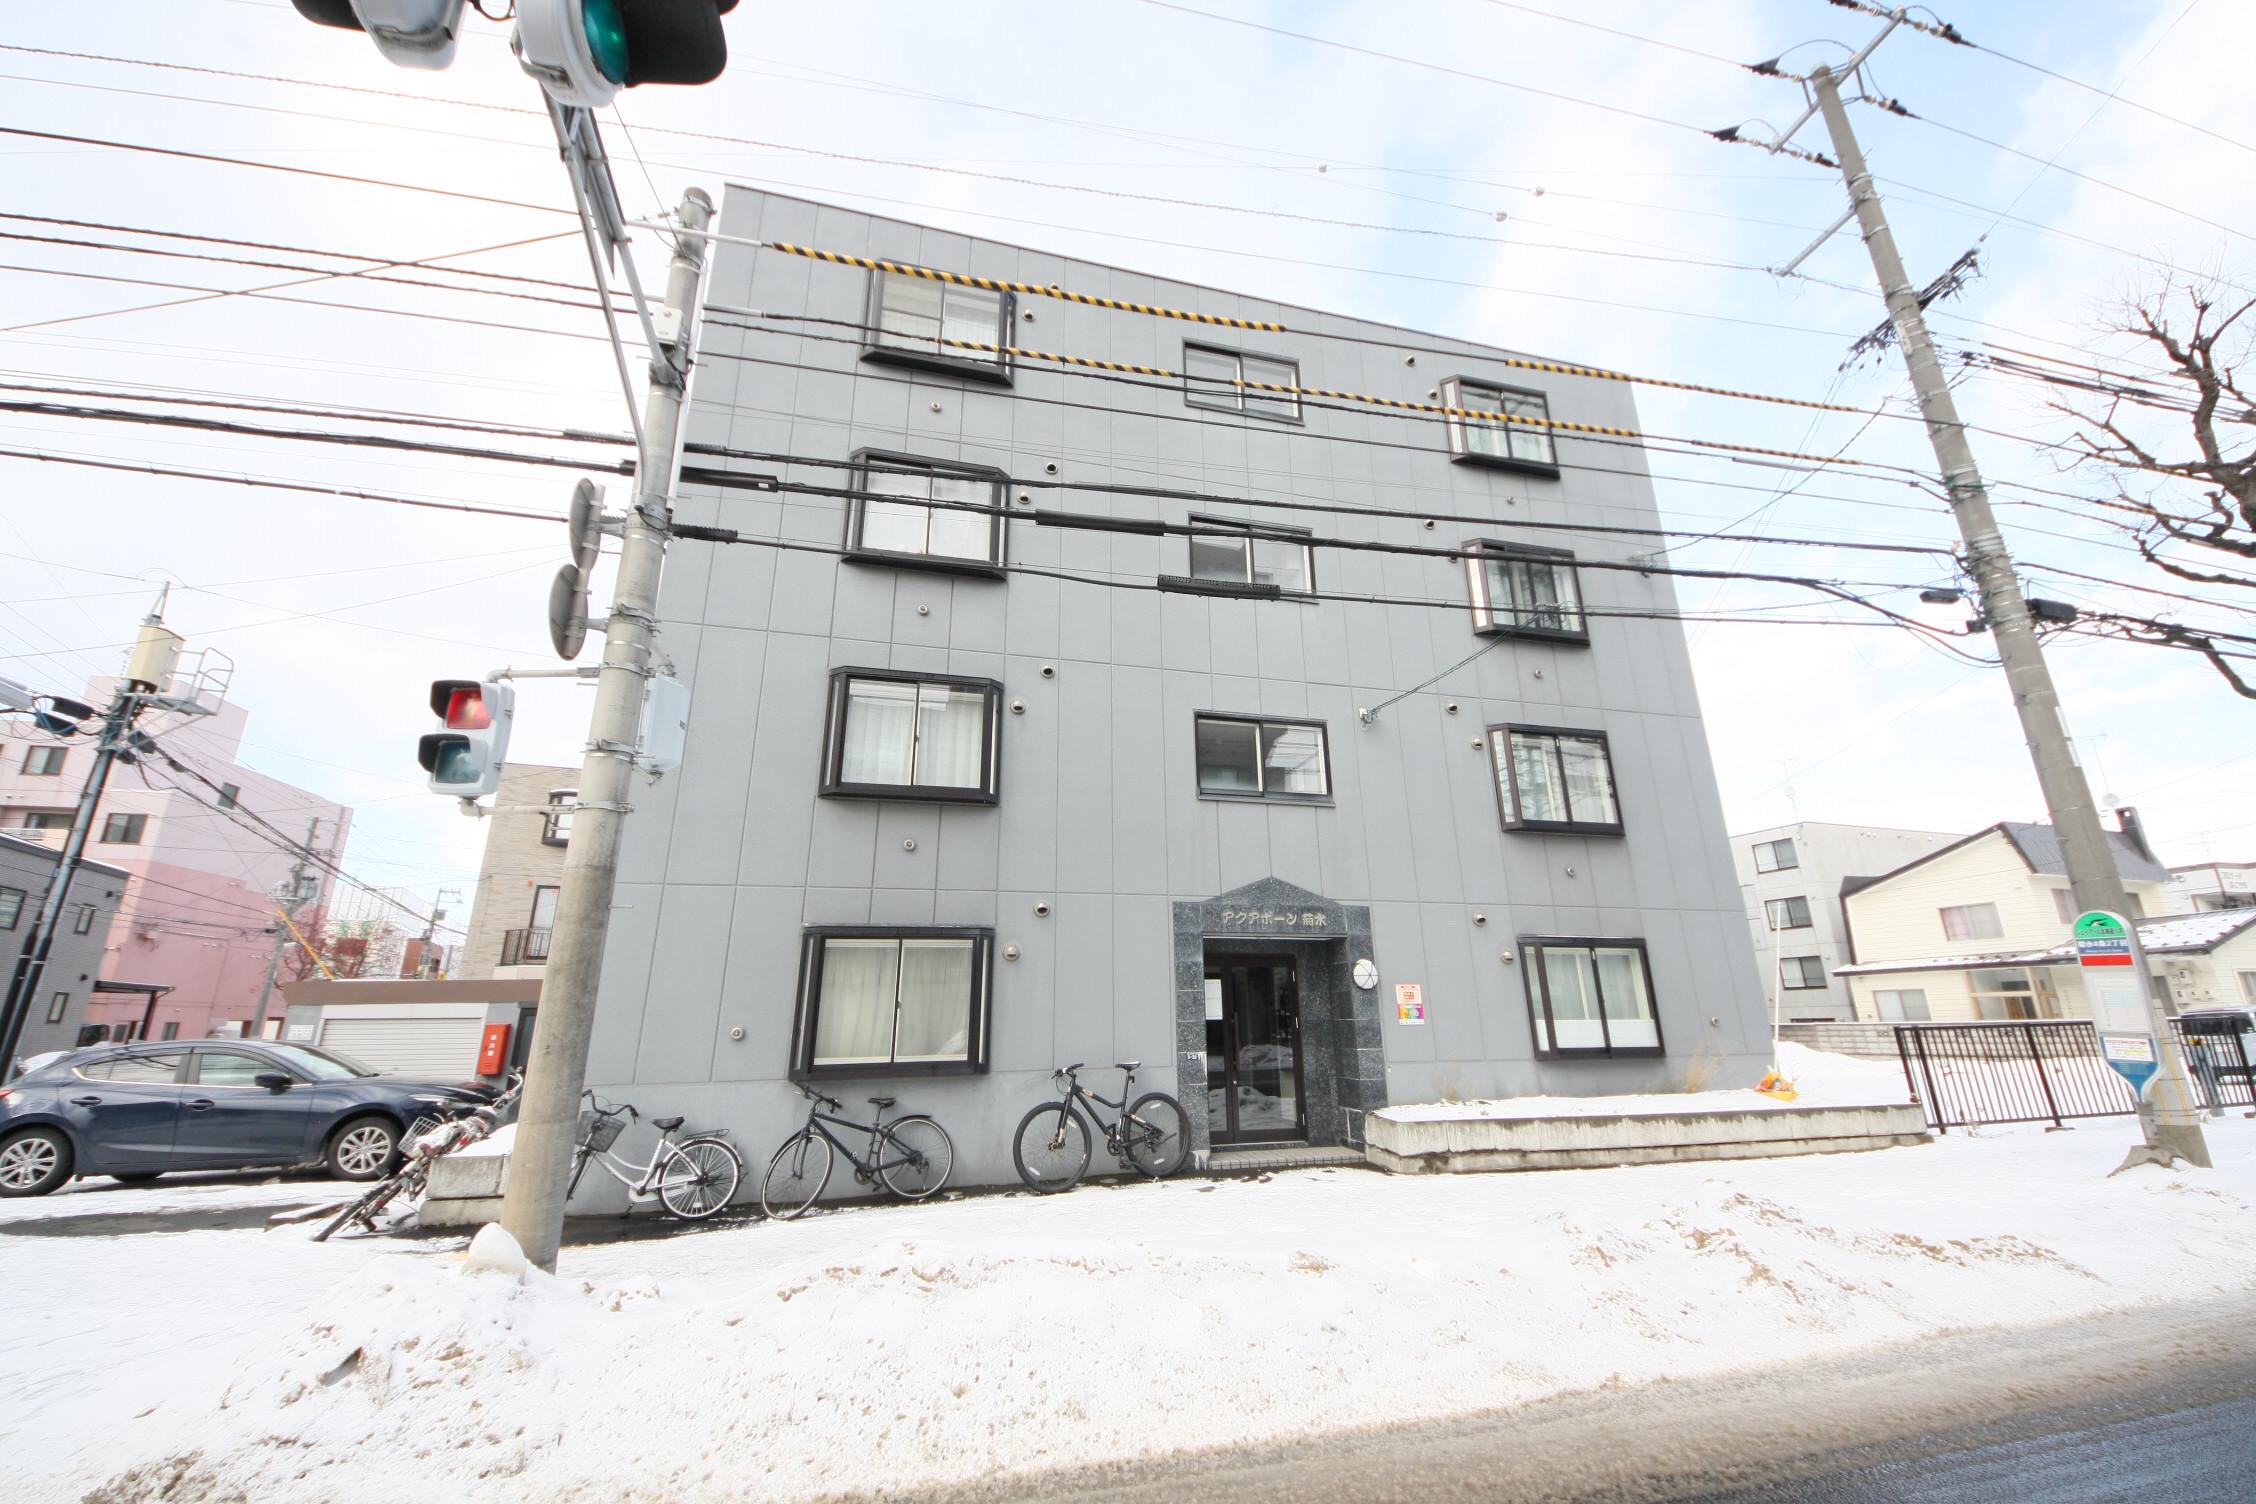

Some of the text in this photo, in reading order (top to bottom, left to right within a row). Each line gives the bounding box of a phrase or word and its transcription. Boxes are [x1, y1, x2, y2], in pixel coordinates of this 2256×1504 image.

[1223, 911, 1328, 927] アクアボーン 菊水
